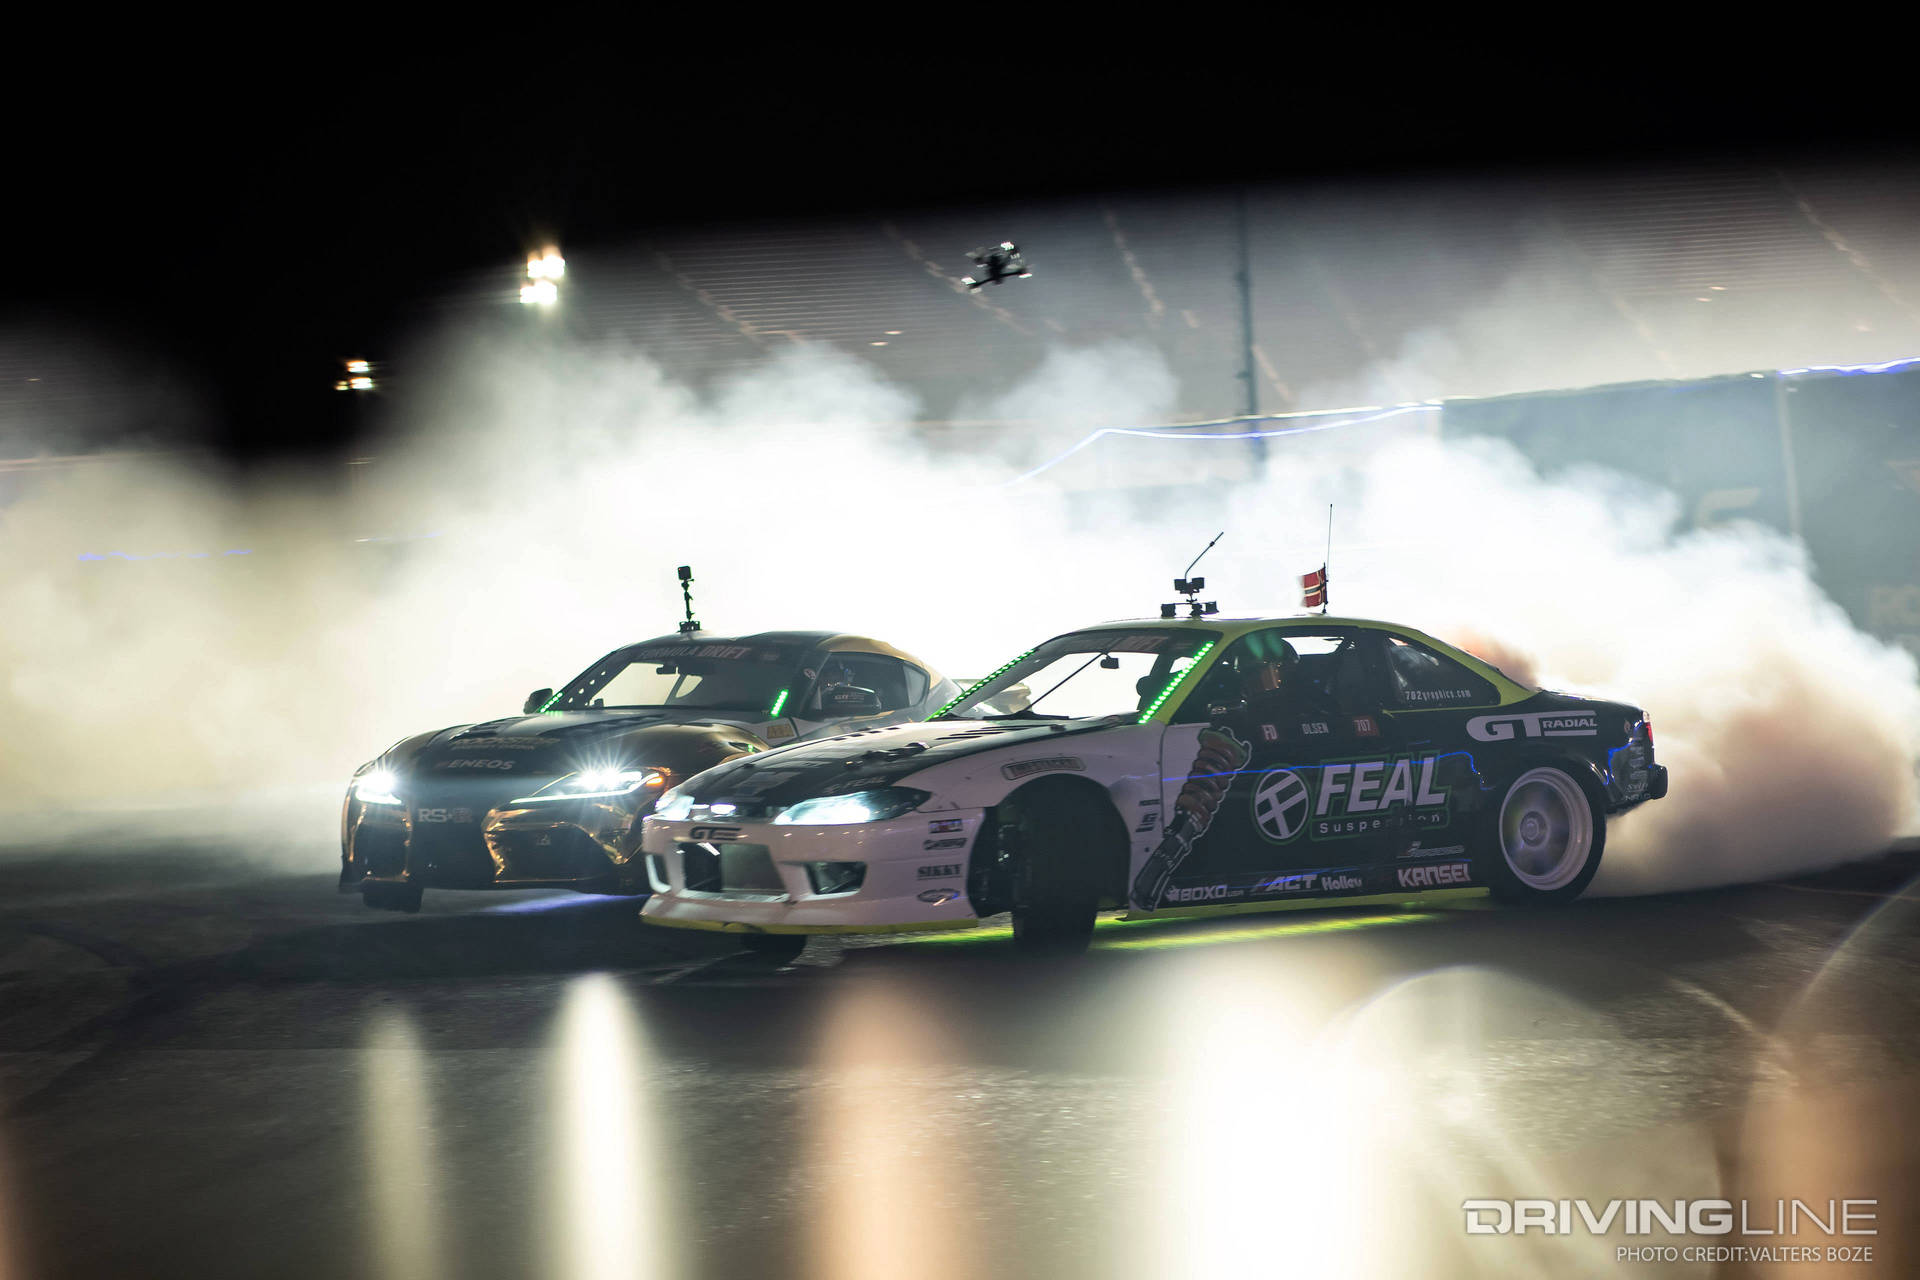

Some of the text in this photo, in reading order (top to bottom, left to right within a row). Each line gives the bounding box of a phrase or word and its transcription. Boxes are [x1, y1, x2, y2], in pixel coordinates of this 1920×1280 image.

[696, 646, 752, 659] DRIFT
[1302, 722, 1329, 735] OLSEN
[1354, 719, 1371, 732] 707
[1466, 712, 1598, 741] GT RADIAL
[448, 760, 516, 772] ENEOS
[1315, 756, 1446, 816] FEAL
[1265, 873, 1317, 891] ACT
[1397, 863, 1472, 888] KANSEI
[1180, 884, 1228, 902] BOXO
